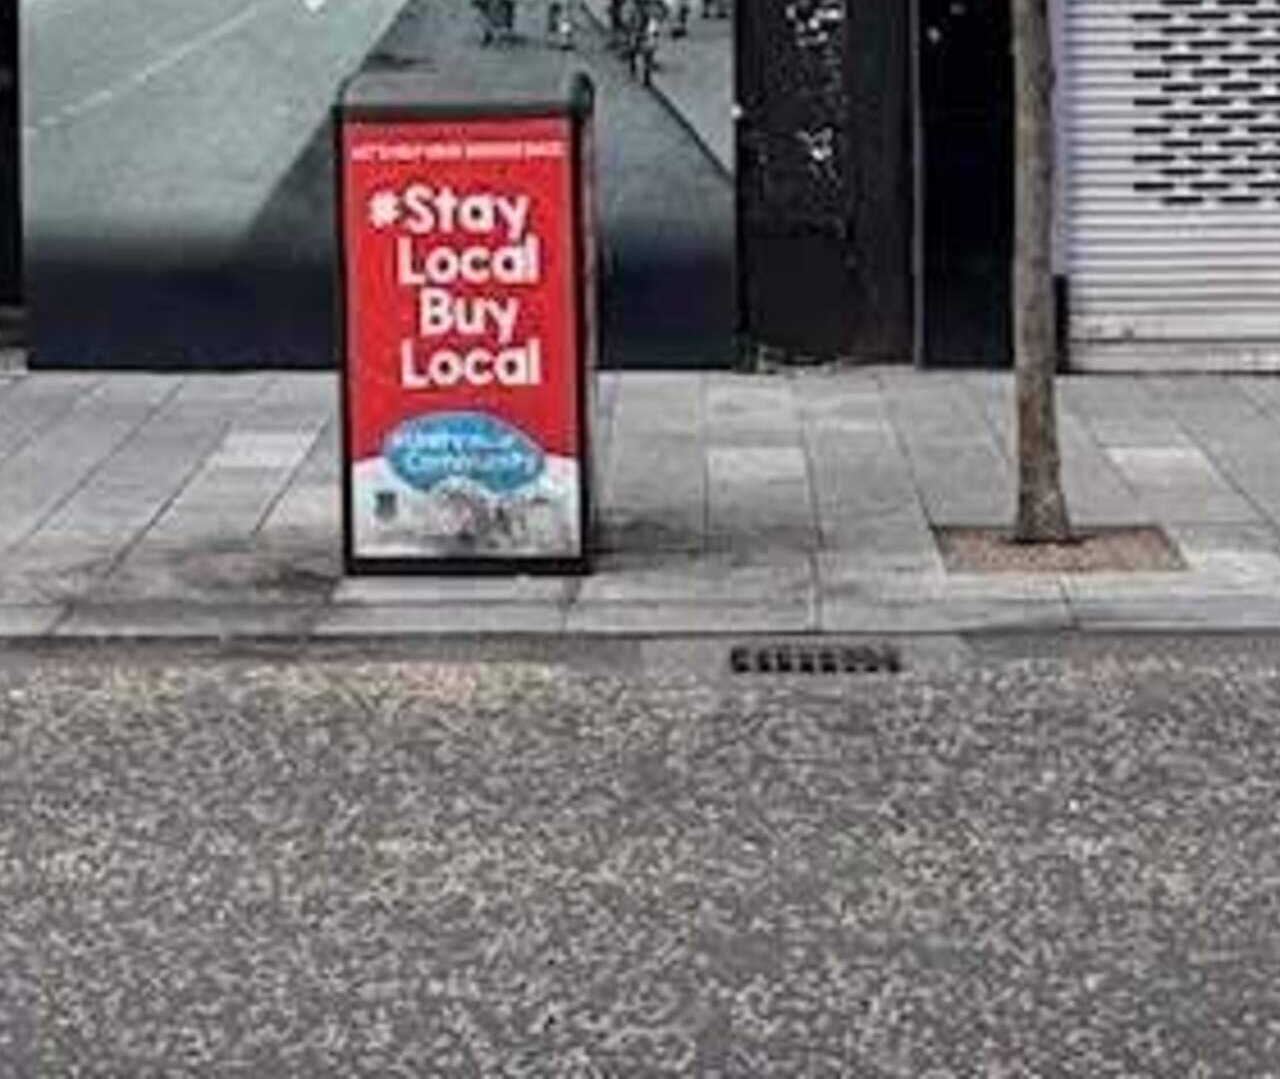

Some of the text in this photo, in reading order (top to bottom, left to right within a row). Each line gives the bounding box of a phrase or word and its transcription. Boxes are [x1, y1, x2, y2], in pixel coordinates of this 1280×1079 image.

[369, 185, 530, 239] #Stay
[397, 234, 539, 285] Local
[420, 287, 519, 343] Buy
[401, 338, 541, 387] Local
